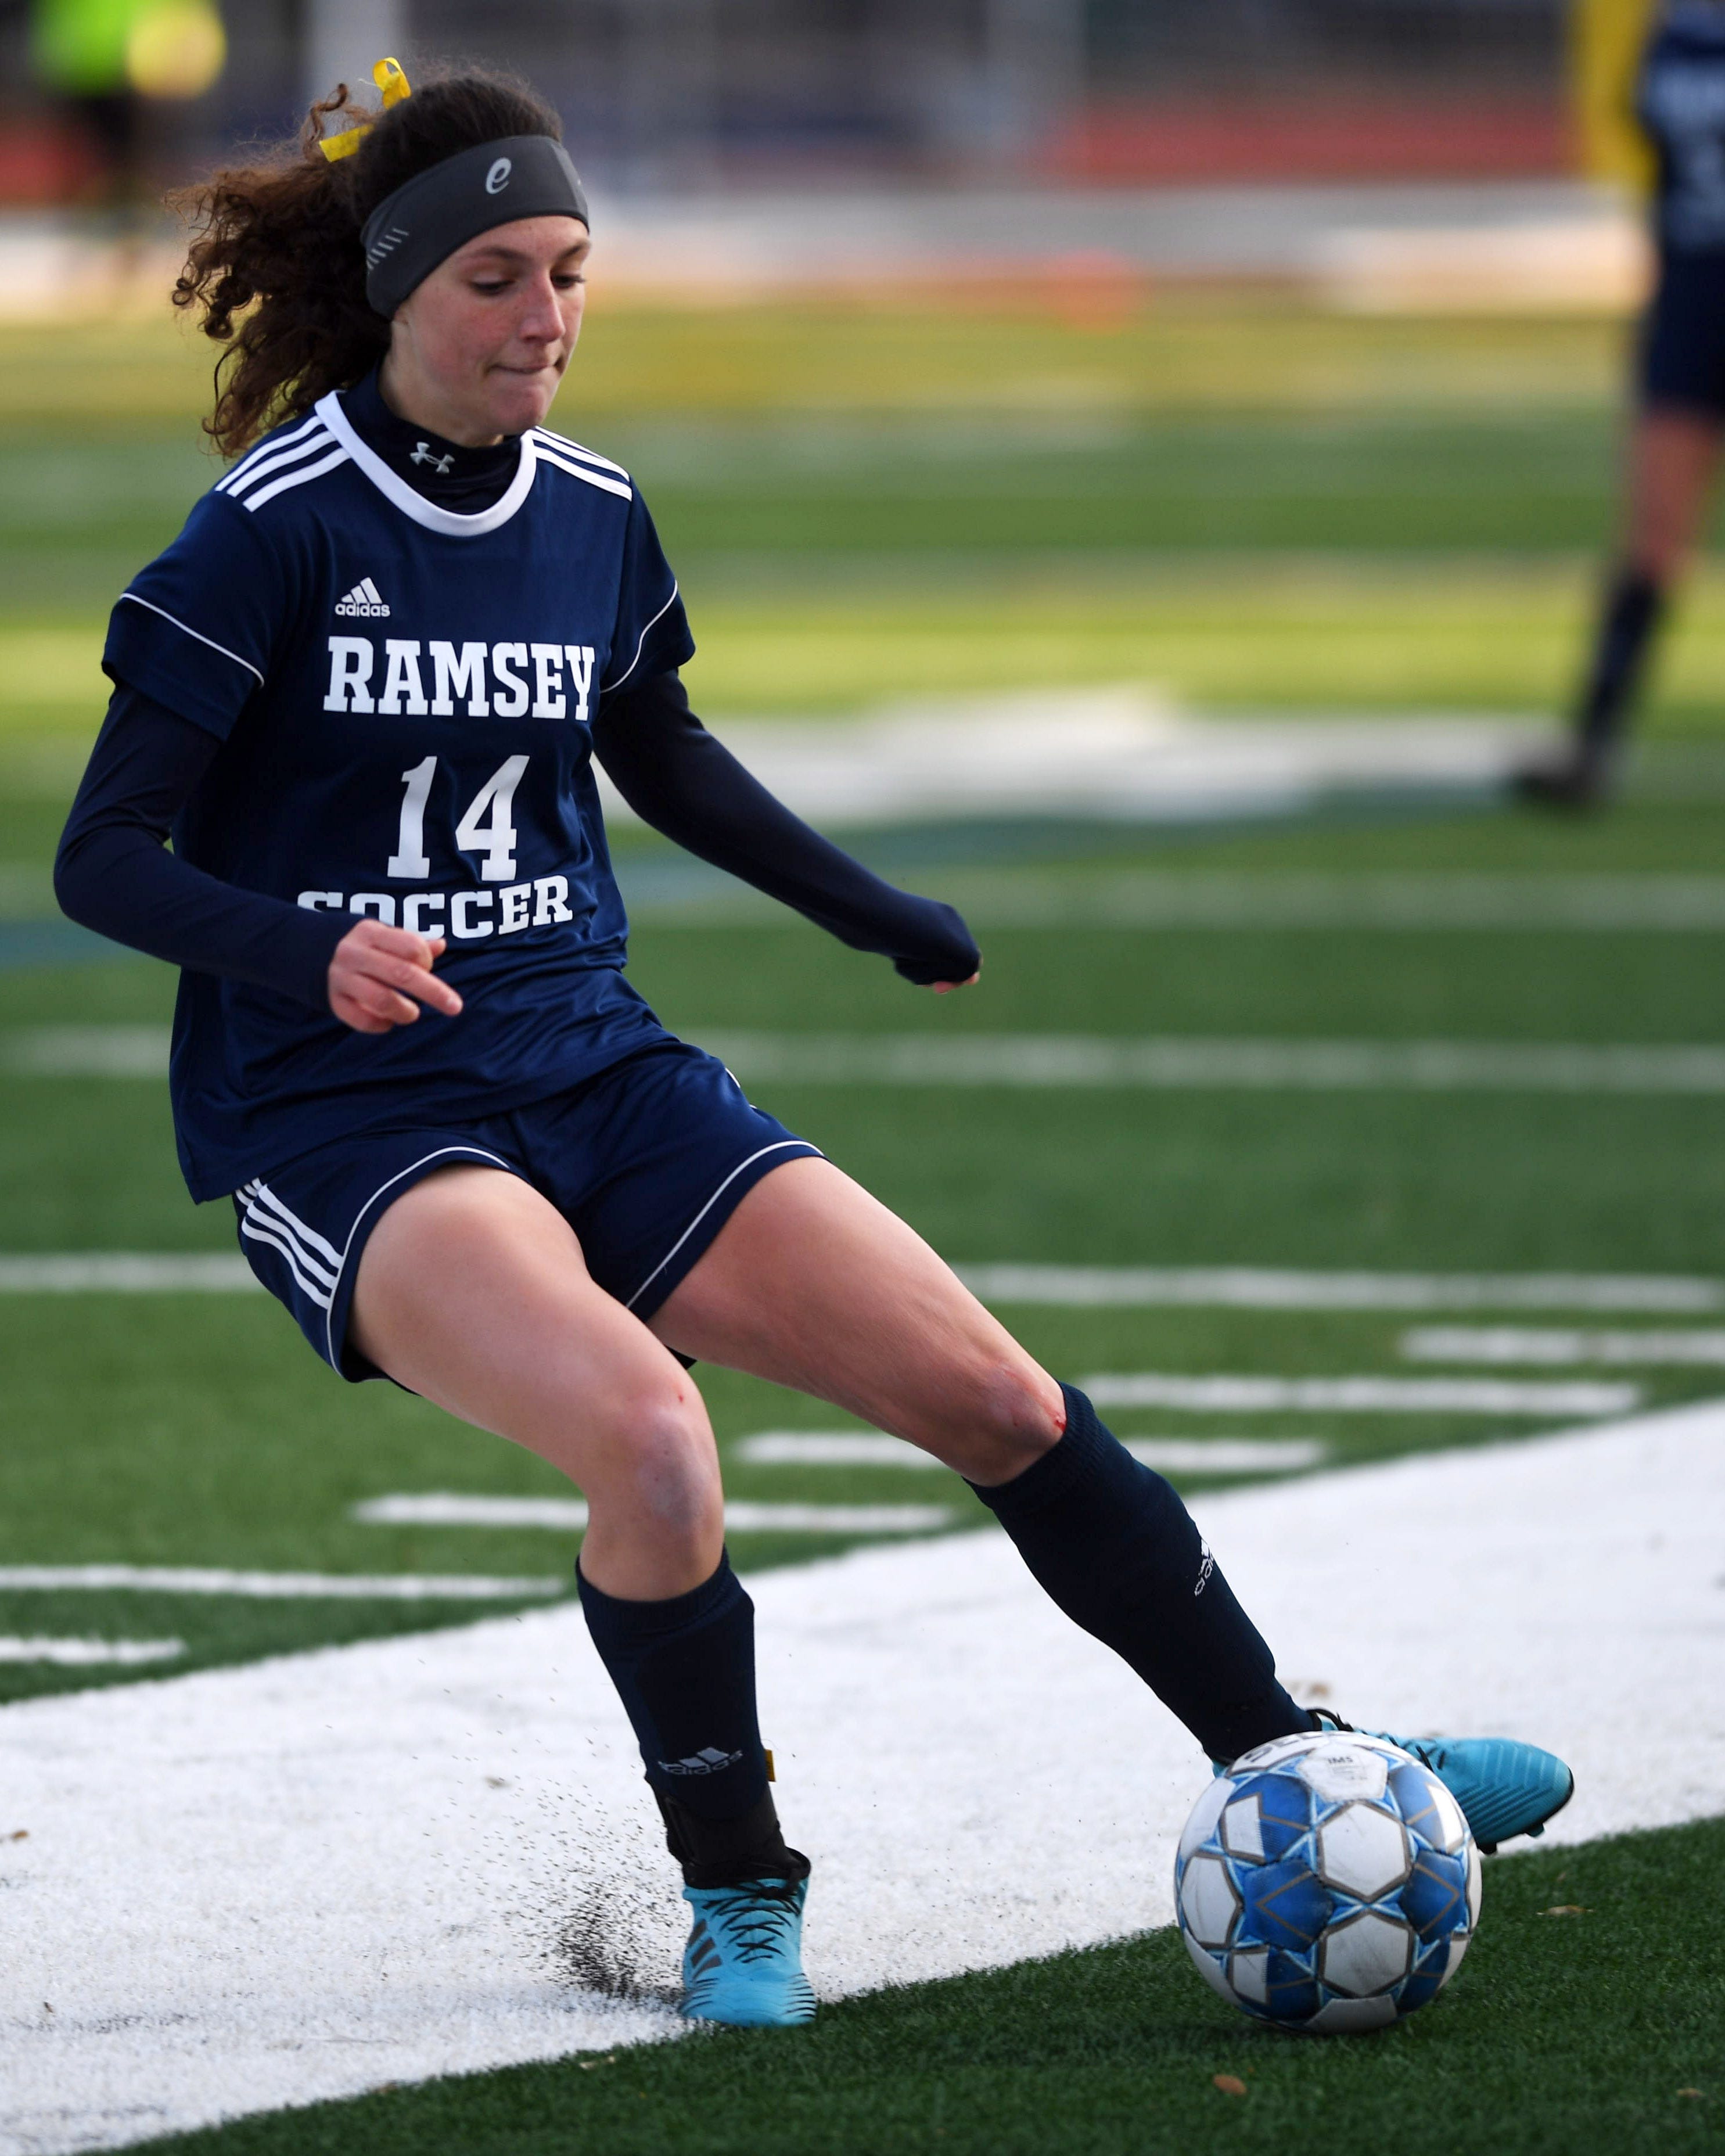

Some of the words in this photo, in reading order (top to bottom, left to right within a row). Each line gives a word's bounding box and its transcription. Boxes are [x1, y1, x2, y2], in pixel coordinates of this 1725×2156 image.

[335, 603, 391, 617] adidas
[323, 636, 595, 721] RAMSEY
[387, 755, 530, 881] 14
